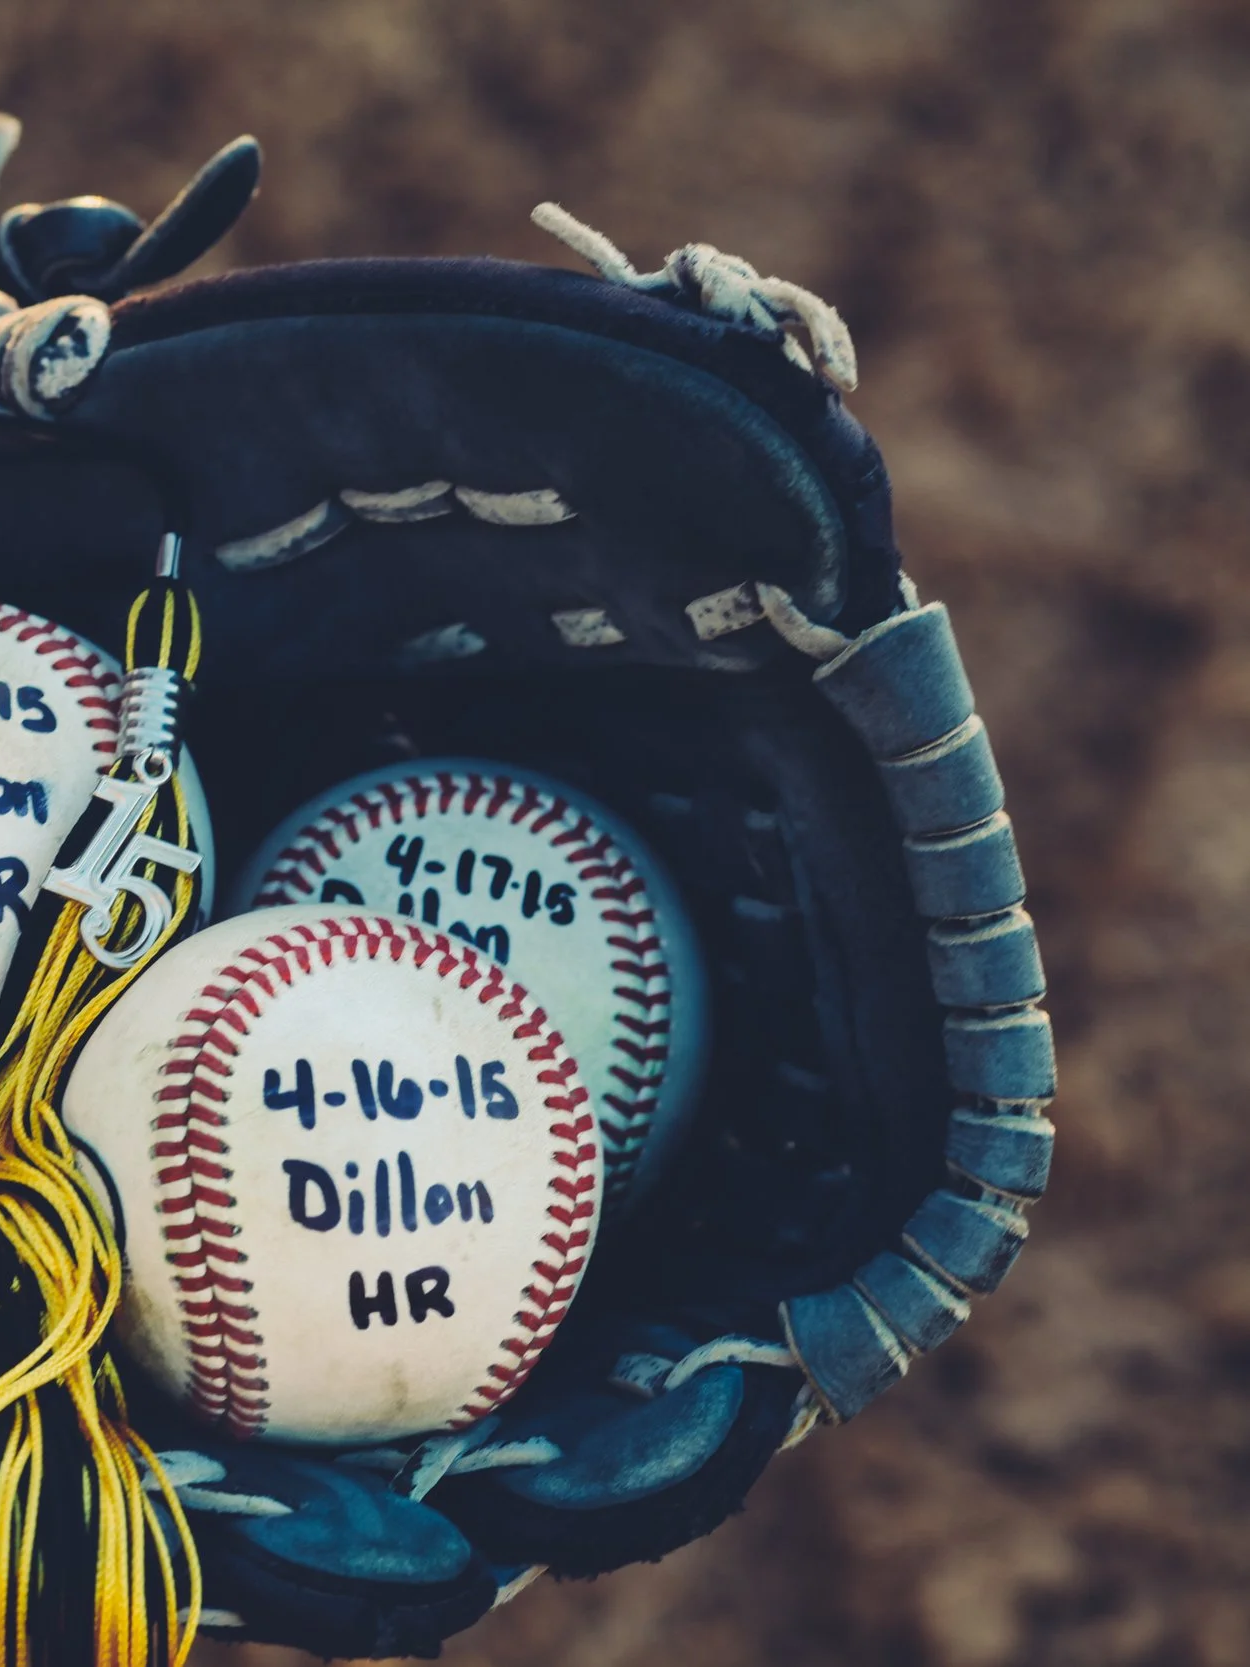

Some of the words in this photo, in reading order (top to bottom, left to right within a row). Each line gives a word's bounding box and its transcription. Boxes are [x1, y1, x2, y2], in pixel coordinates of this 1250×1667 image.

[41, 775, 204, 970] 15
[263, 1054, 519, 1130] 4-16-15
[282, 1150, 494, 1237] Dillon
[348, 1265, 455, 1330] HR
